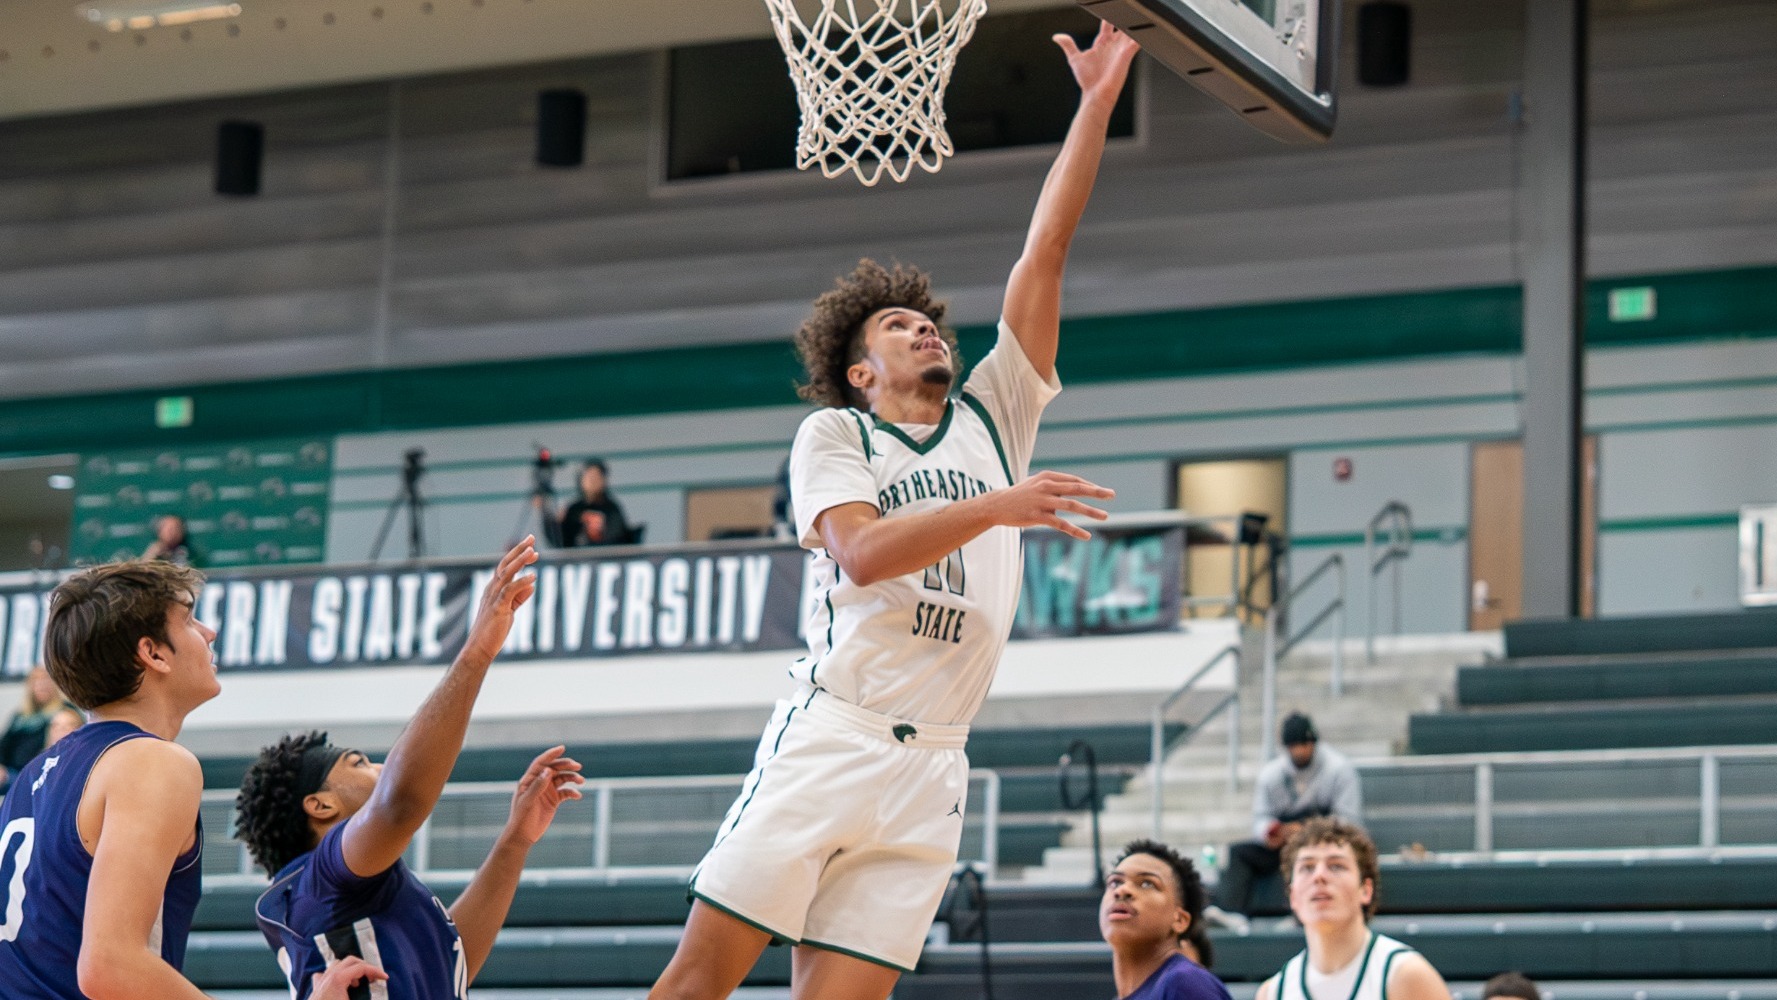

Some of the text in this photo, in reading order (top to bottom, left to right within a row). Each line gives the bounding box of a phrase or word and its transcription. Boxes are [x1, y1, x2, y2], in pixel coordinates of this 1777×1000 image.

[878, 468, 993, 517] ORTHEASTER
[308, 566, 448, 664] STATE
[911, 600, 966, 643] STATE
